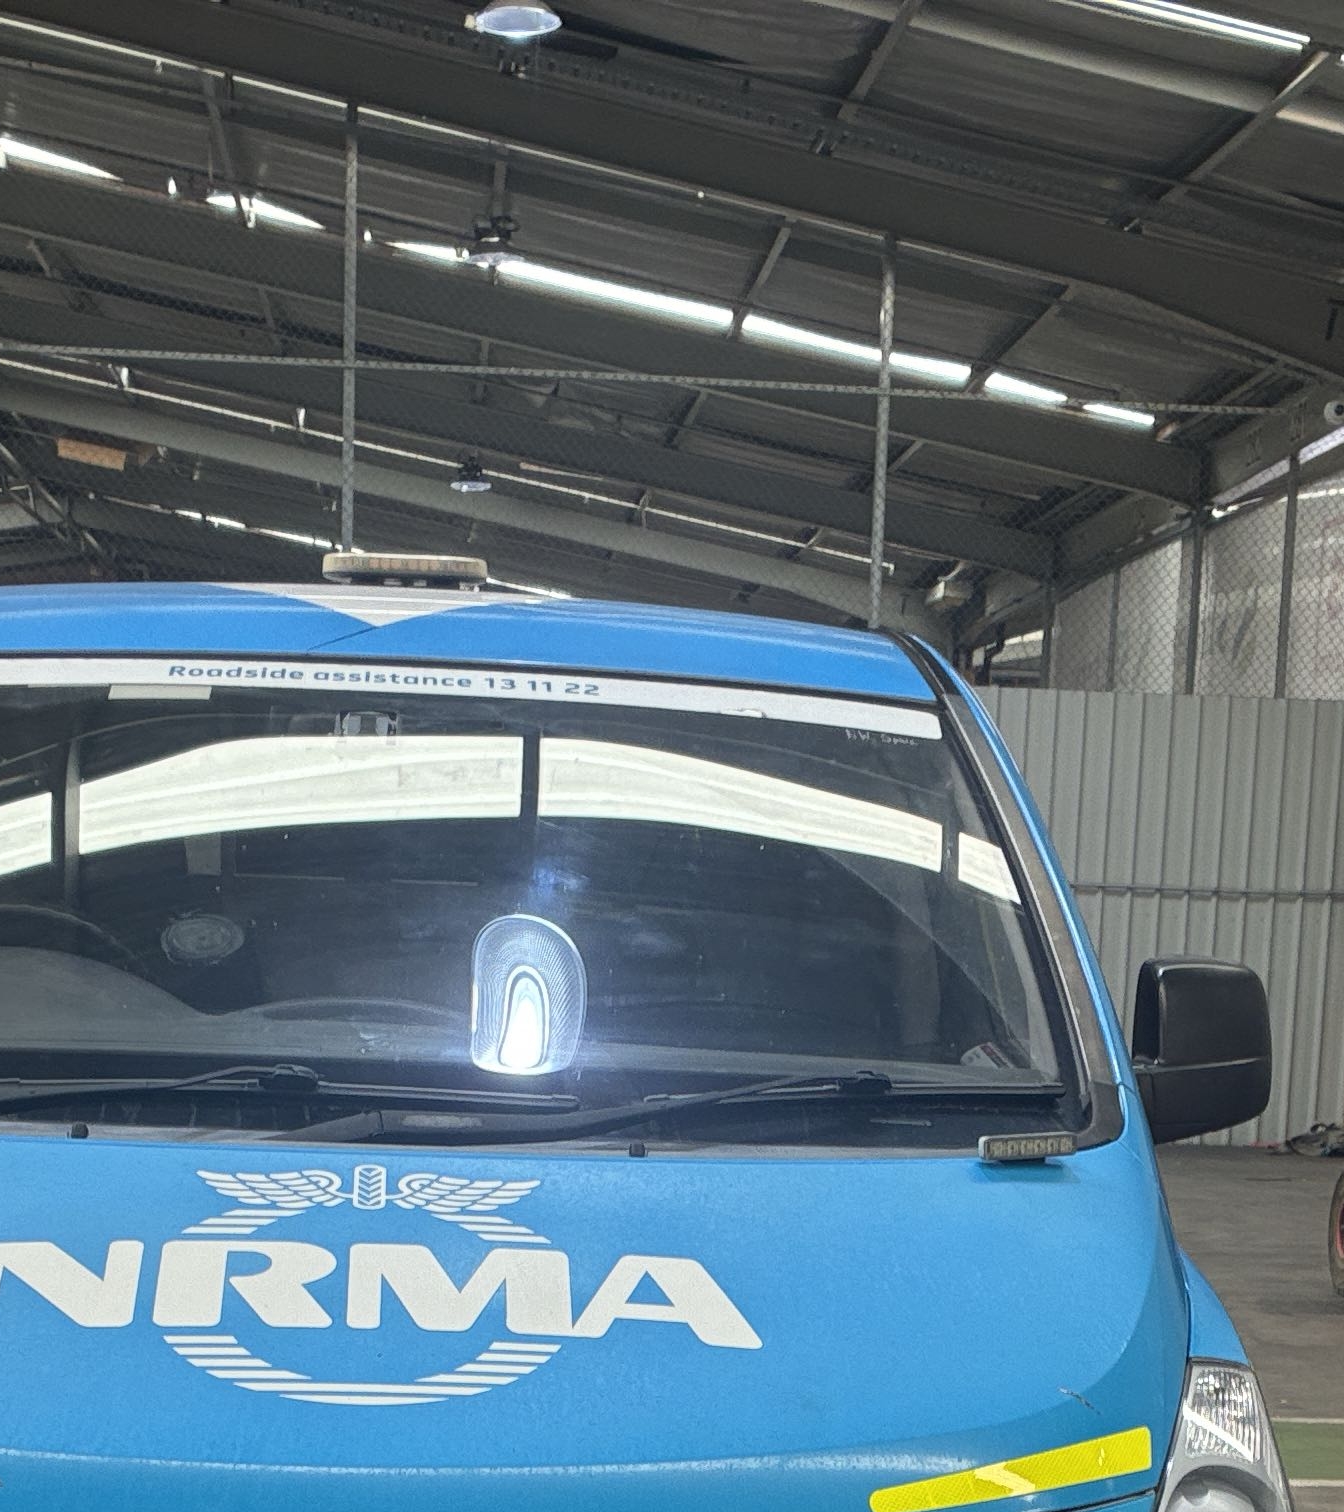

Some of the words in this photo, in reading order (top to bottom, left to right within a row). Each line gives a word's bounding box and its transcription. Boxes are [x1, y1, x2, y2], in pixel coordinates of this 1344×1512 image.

[167, 664, 305, 682] Roadside
[313, 670, 472, 689] assistance
[484, 677, 518, 692] 13
[527, 680, 553, 694] 11
[564, 683, 600, 697] 22
